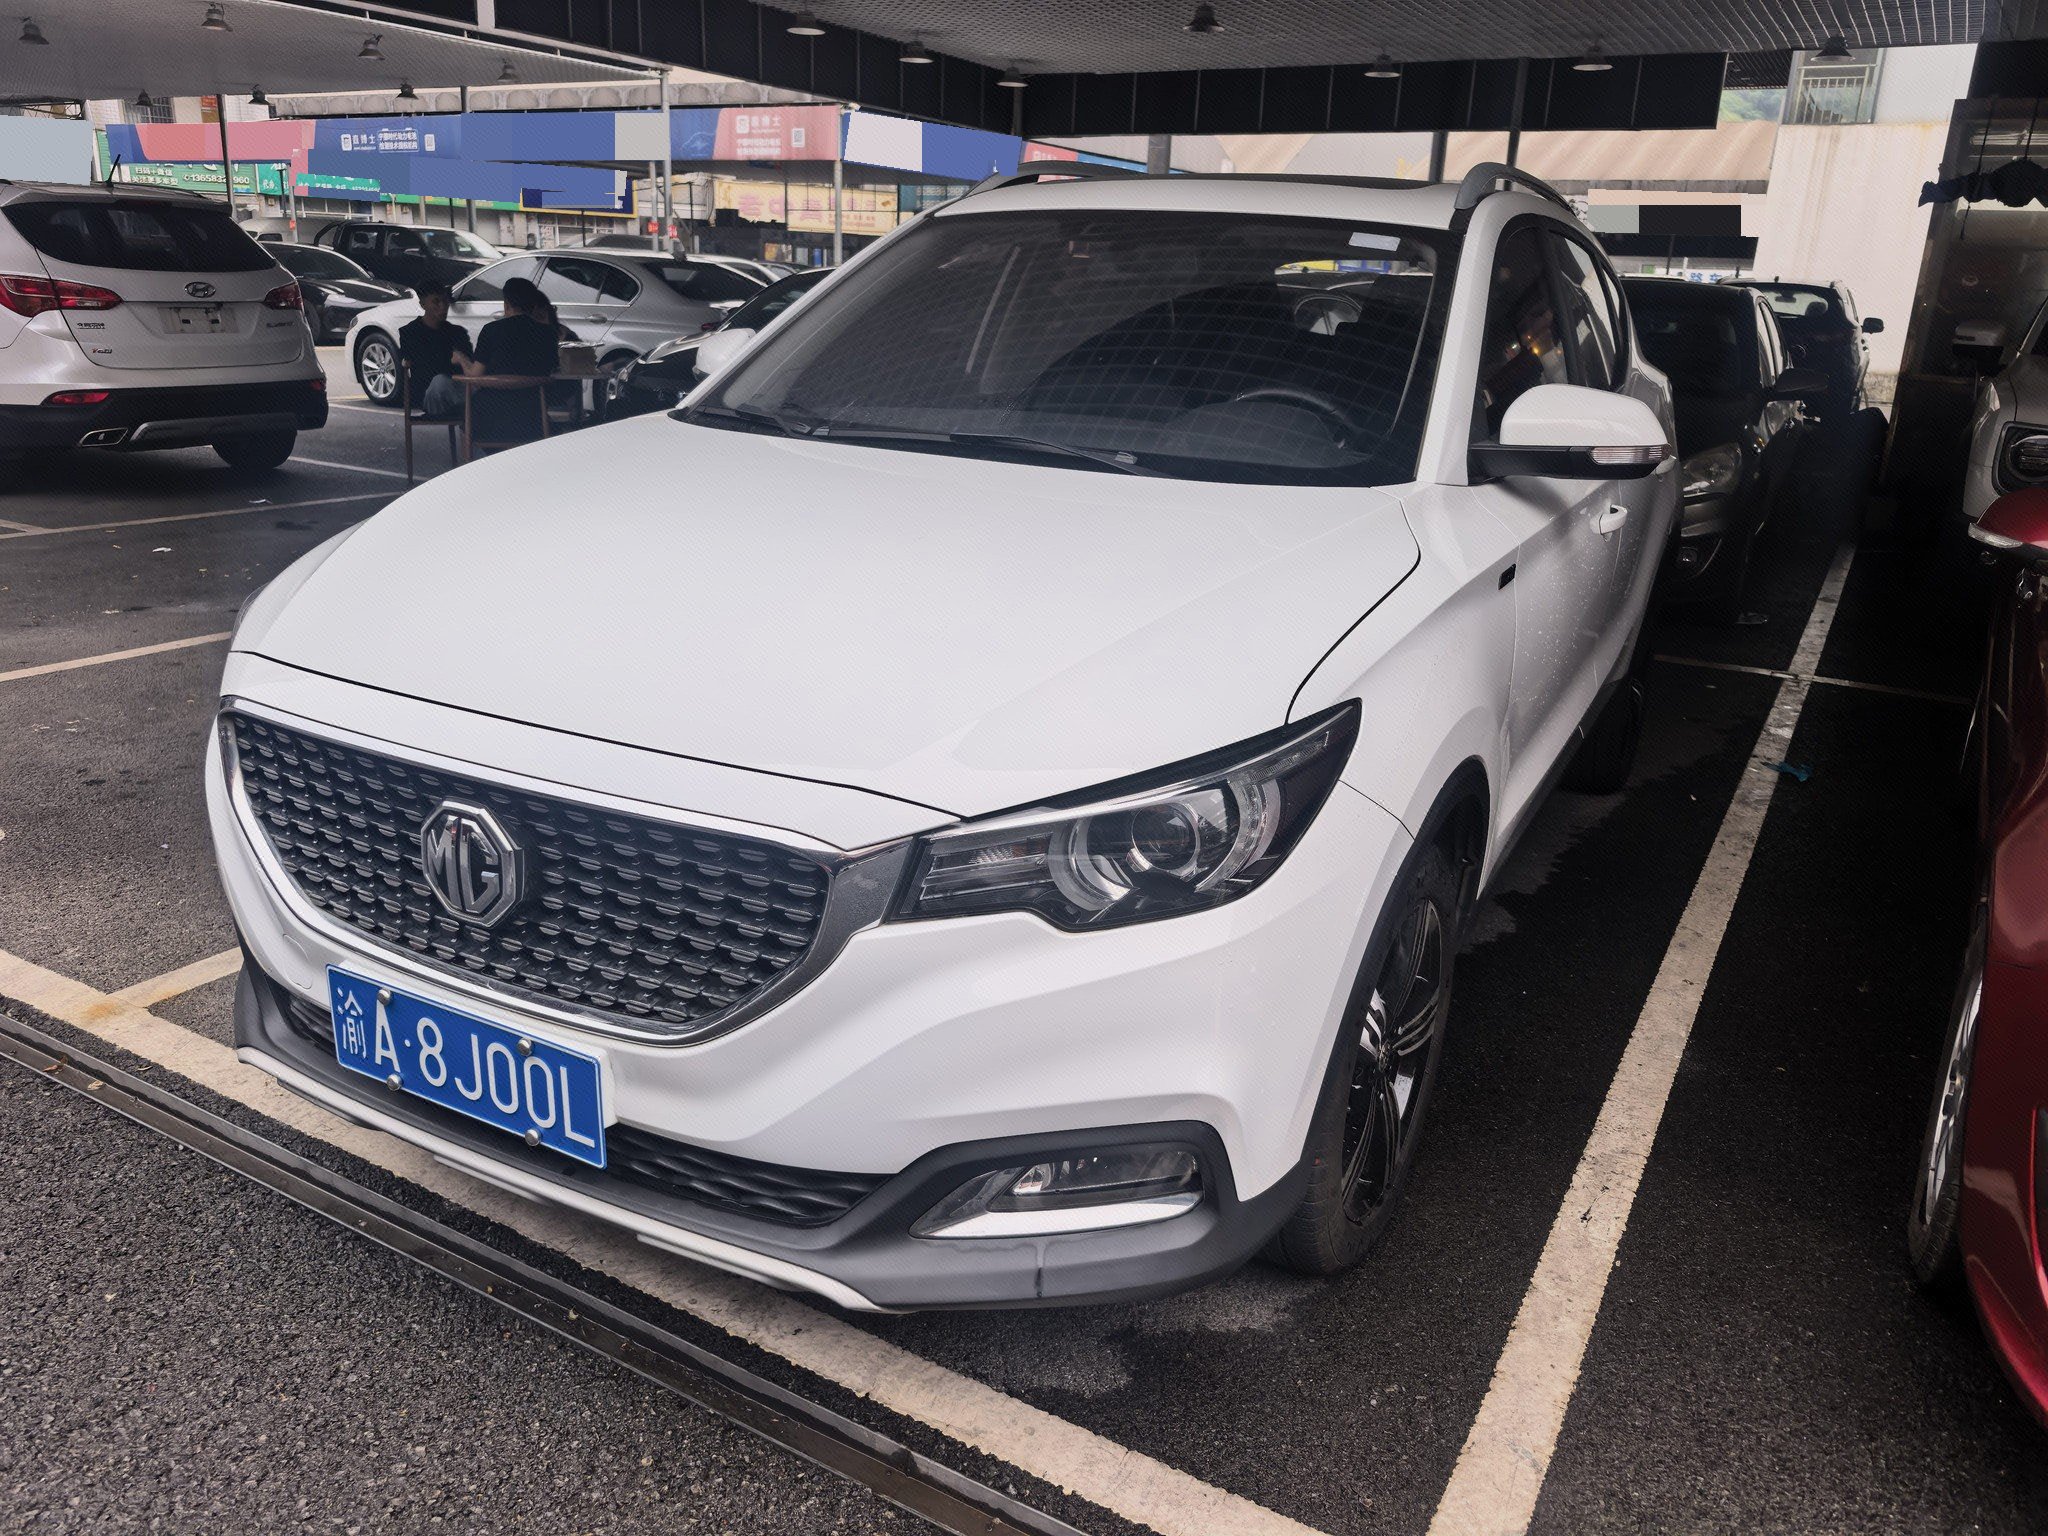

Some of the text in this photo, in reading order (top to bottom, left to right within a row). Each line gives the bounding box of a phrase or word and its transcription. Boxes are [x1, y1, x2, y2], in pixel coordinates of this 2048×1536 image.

[191, 174, 251, 185] 1365832960
[424, 812, 501, 916] MG
[337, 985, 595, 1149] 渝A·8J00L
